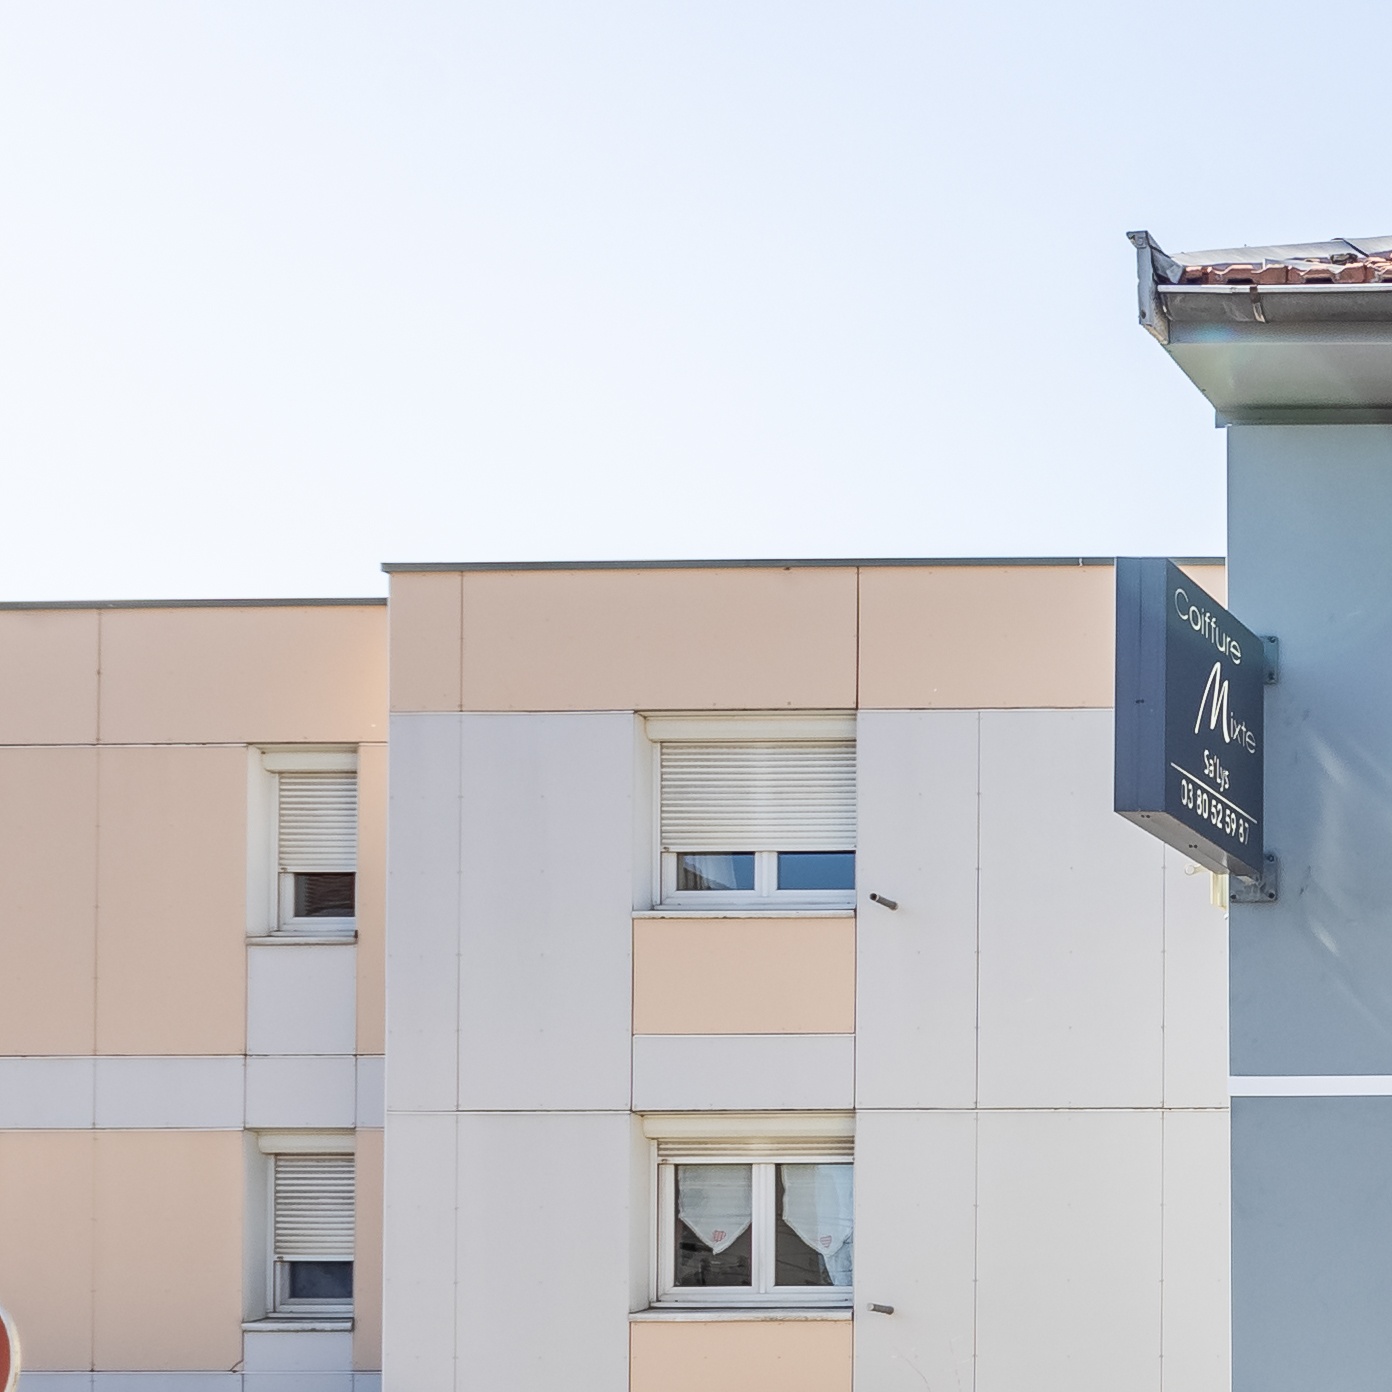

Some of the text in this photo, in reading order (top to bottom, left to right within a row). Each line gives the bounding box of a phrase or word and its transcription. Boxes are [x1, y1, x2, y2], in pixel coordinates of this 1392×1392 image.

[1174, 588, 1242, 665] Coiffure
[1194, 661, 1256, 754] Mixte
[1180, 778, 1194, 810] 03
[1196, 789, 1209, 820] 80
[1210, 799, 1223, 830] 52
[1224, 814, 1237, 837] 59
